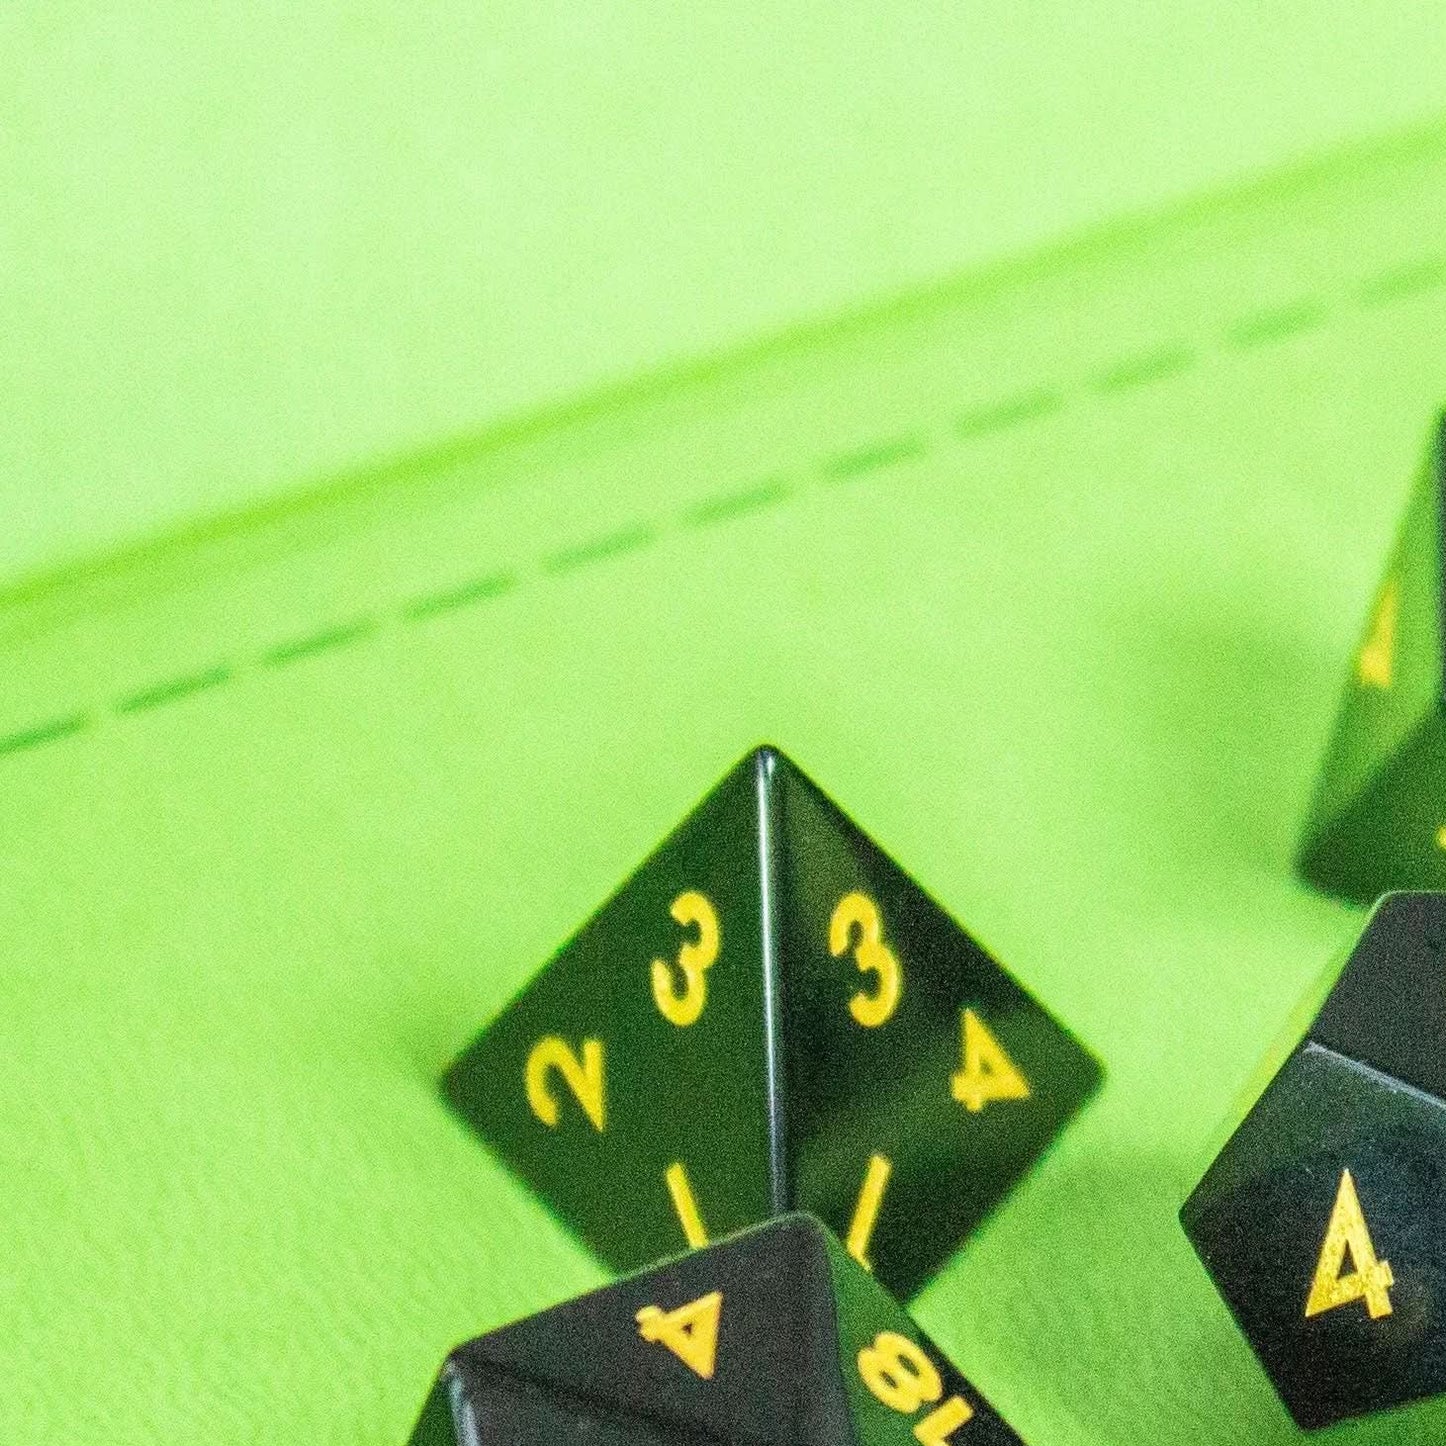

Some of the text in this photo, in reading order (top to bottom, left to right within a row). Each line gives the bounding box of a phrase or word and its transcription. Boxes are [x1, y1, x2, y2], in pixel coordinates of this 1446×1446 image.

[650, 890, 722, 1029] 3
[827, 889, 903, 1029] 3
[523, 1035, 606, 1133] 2
[950, 1007, 1032, 1114] 4
[1304, 1167, 1394, 1320] 4
[635, 1290, 724, 1379] 4
